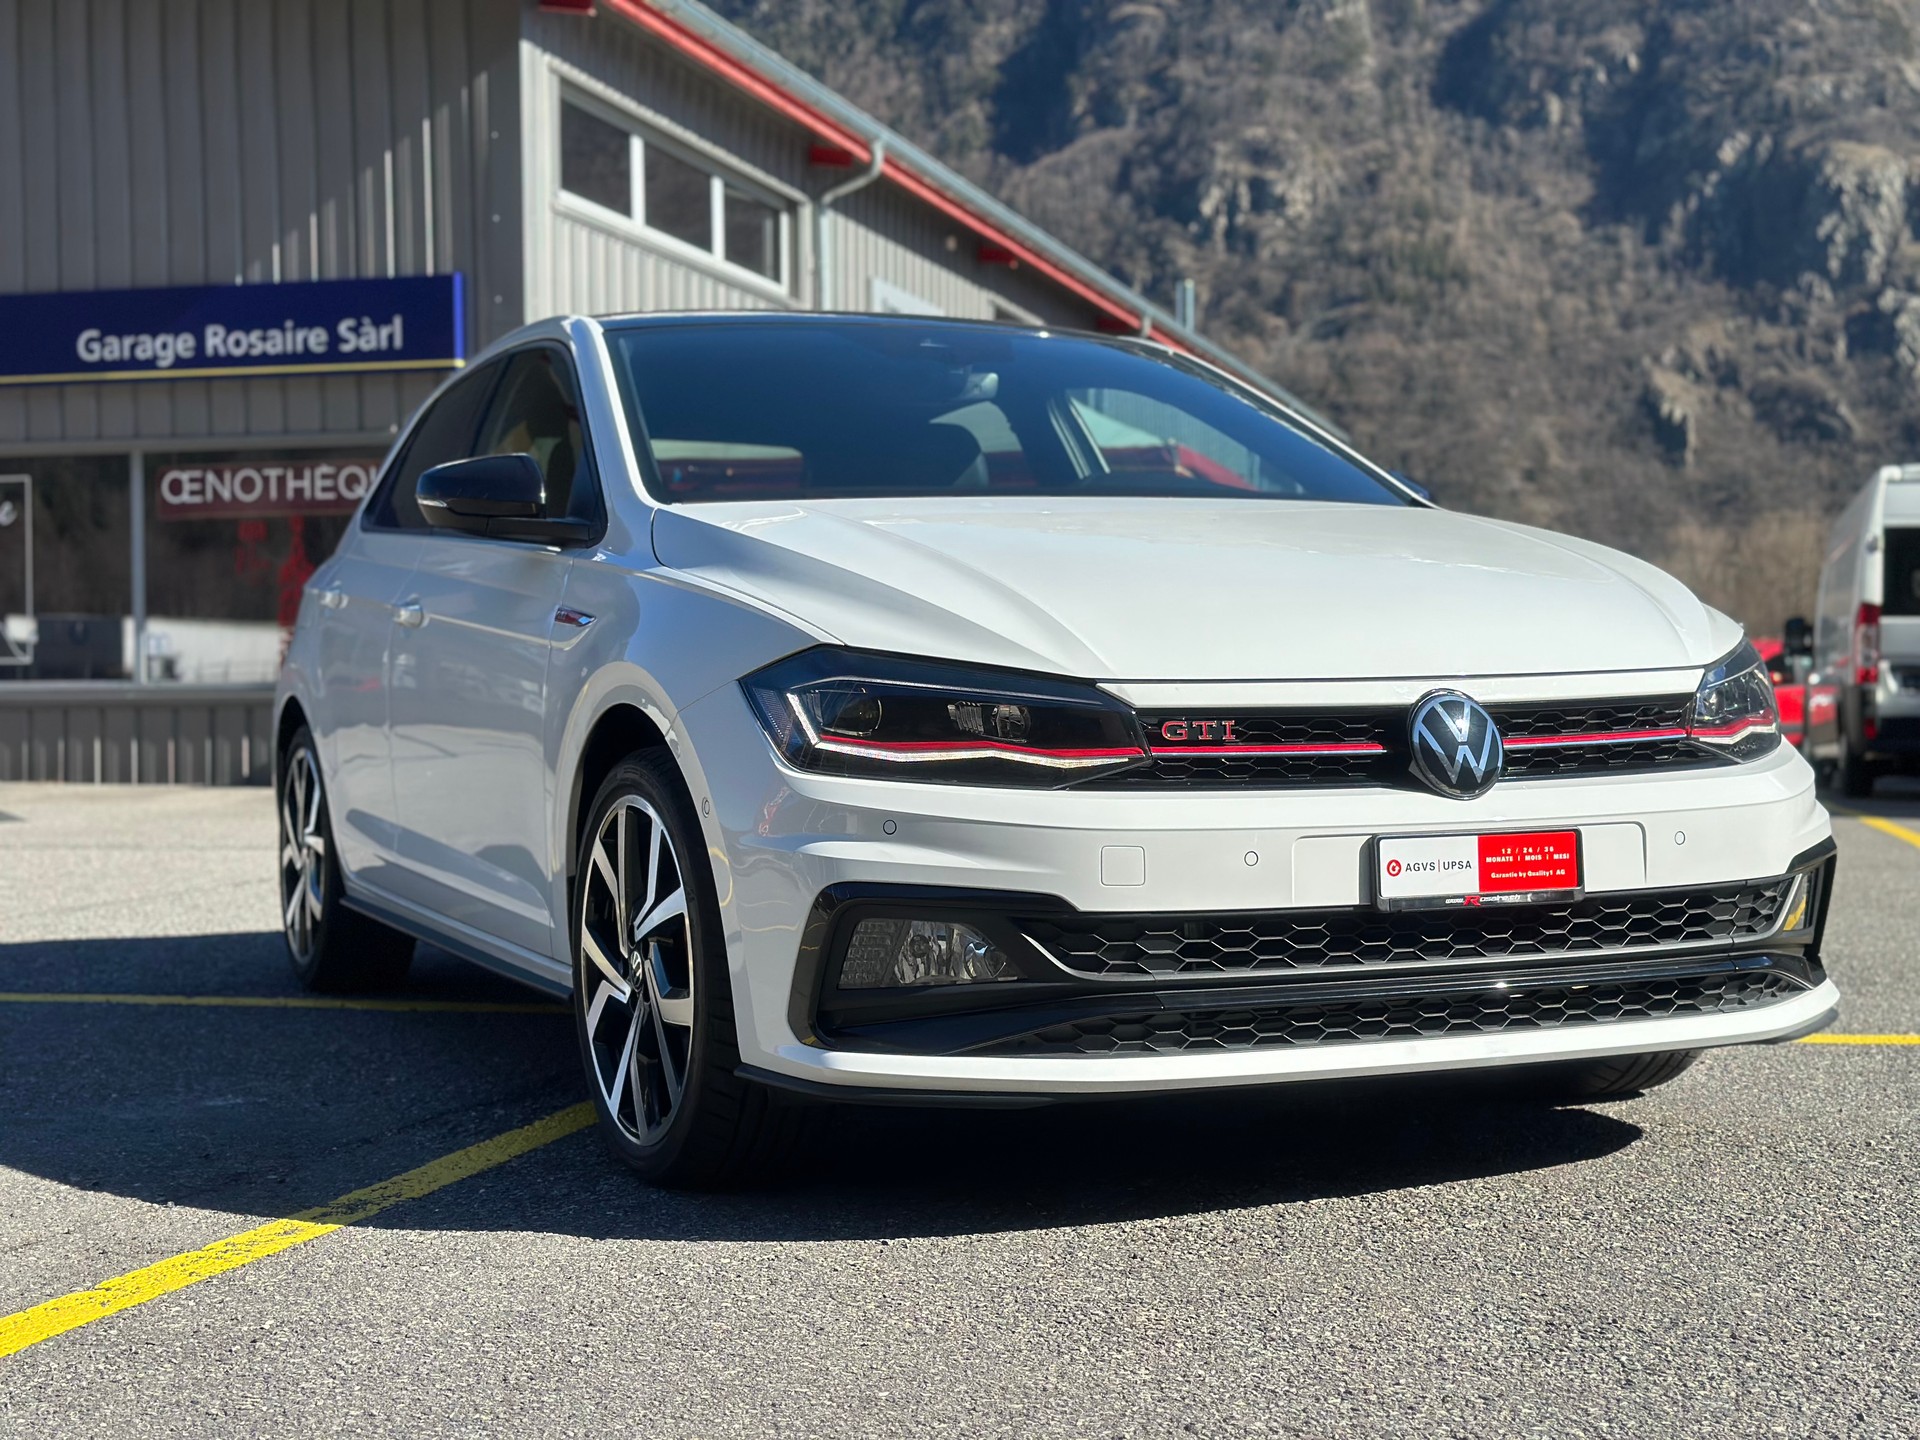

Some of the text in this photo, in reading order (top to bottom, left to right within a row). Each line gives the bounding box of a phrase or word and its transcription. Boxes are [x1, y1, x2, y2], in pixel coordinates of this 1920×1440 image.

[76, 314, 404, 368] Garage Rosaire Sàrl
[1161, 720, 1236, 741] GTI
[1405, 860, 1472, 872] AGVS UPSA
[1519, 870, 1526, 878] by
